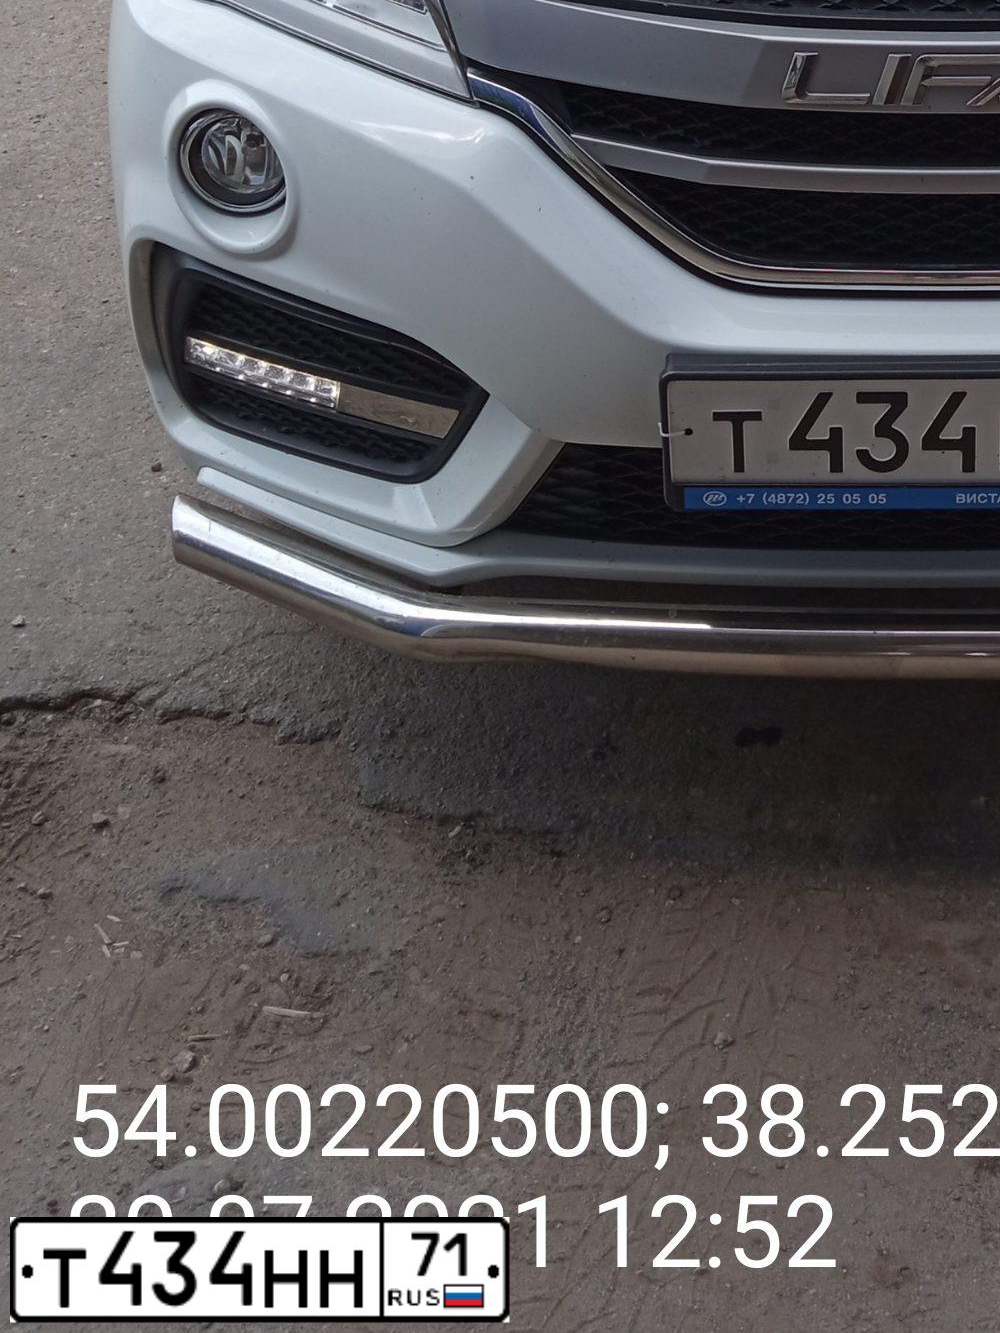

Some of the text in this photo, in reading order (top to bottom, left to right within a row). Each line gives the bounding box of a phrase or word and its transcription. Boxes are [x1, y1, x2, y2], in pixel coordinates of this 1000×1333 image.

[736, 492, 887, 506] +7 (4872) 25 05 05
